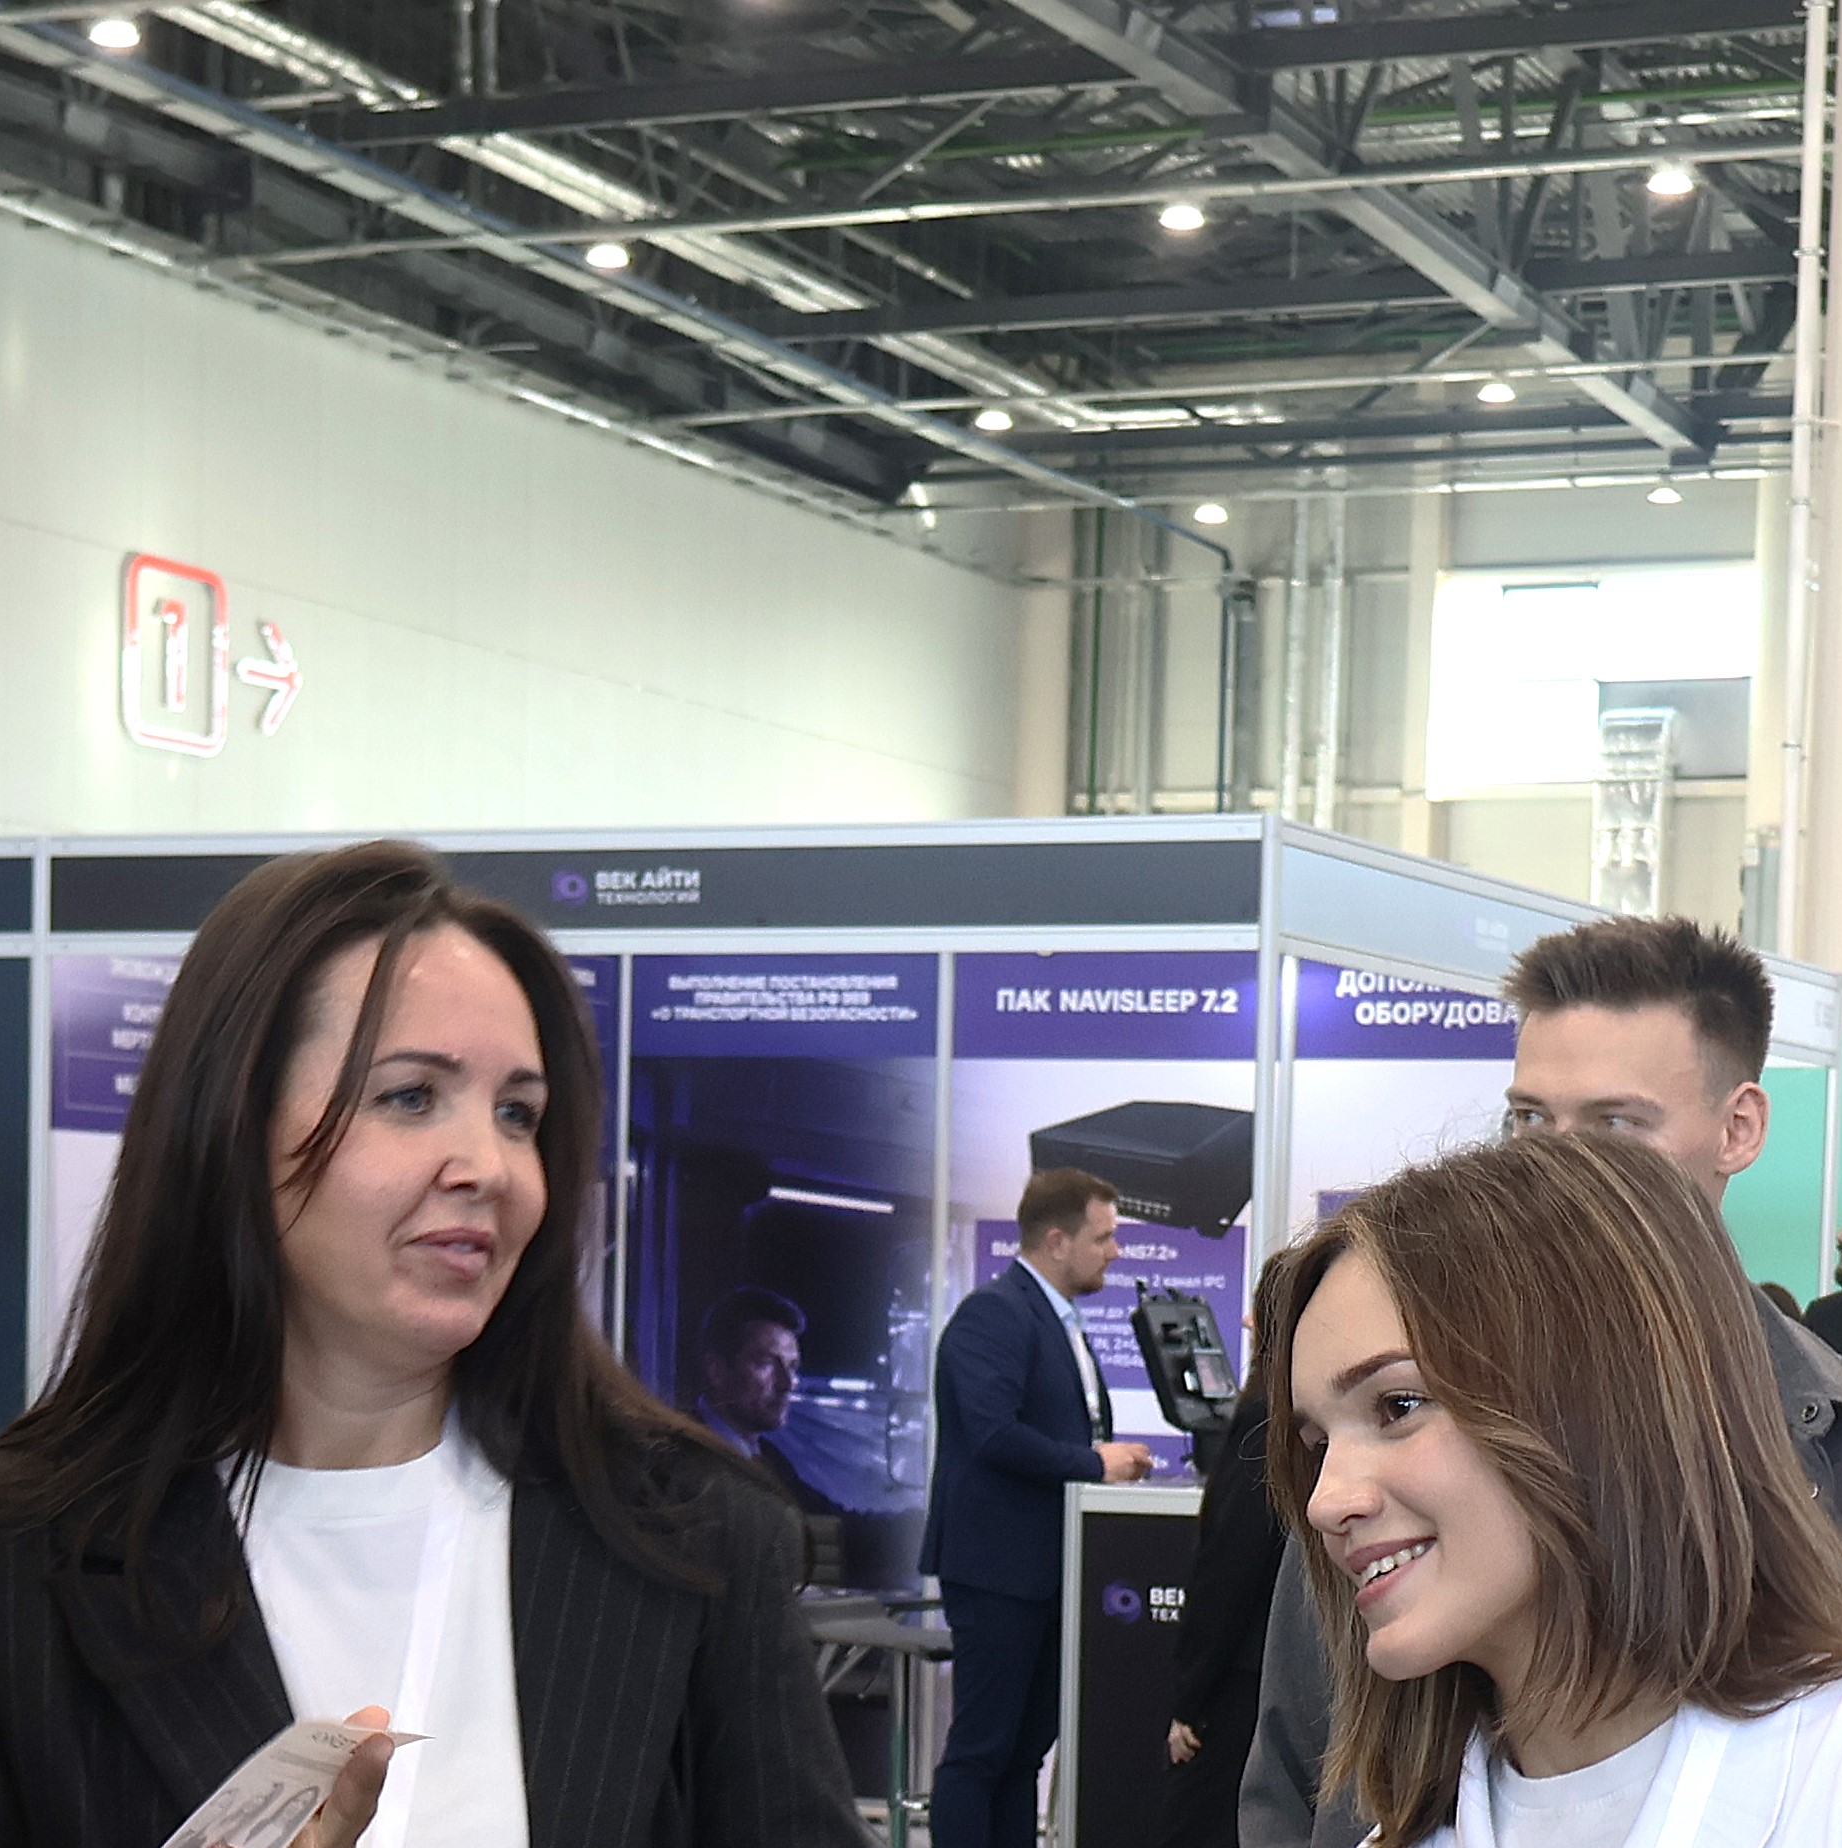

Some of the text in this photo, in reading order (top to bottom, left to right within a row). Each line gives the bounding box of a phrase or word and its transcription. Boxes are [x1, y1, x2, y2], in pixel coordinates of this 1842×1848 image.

[594, 865, 701, 889] ВЕК АЙТИ
[996, 987, 1239, 1014] ПАК NAVISLEEP 7.2
